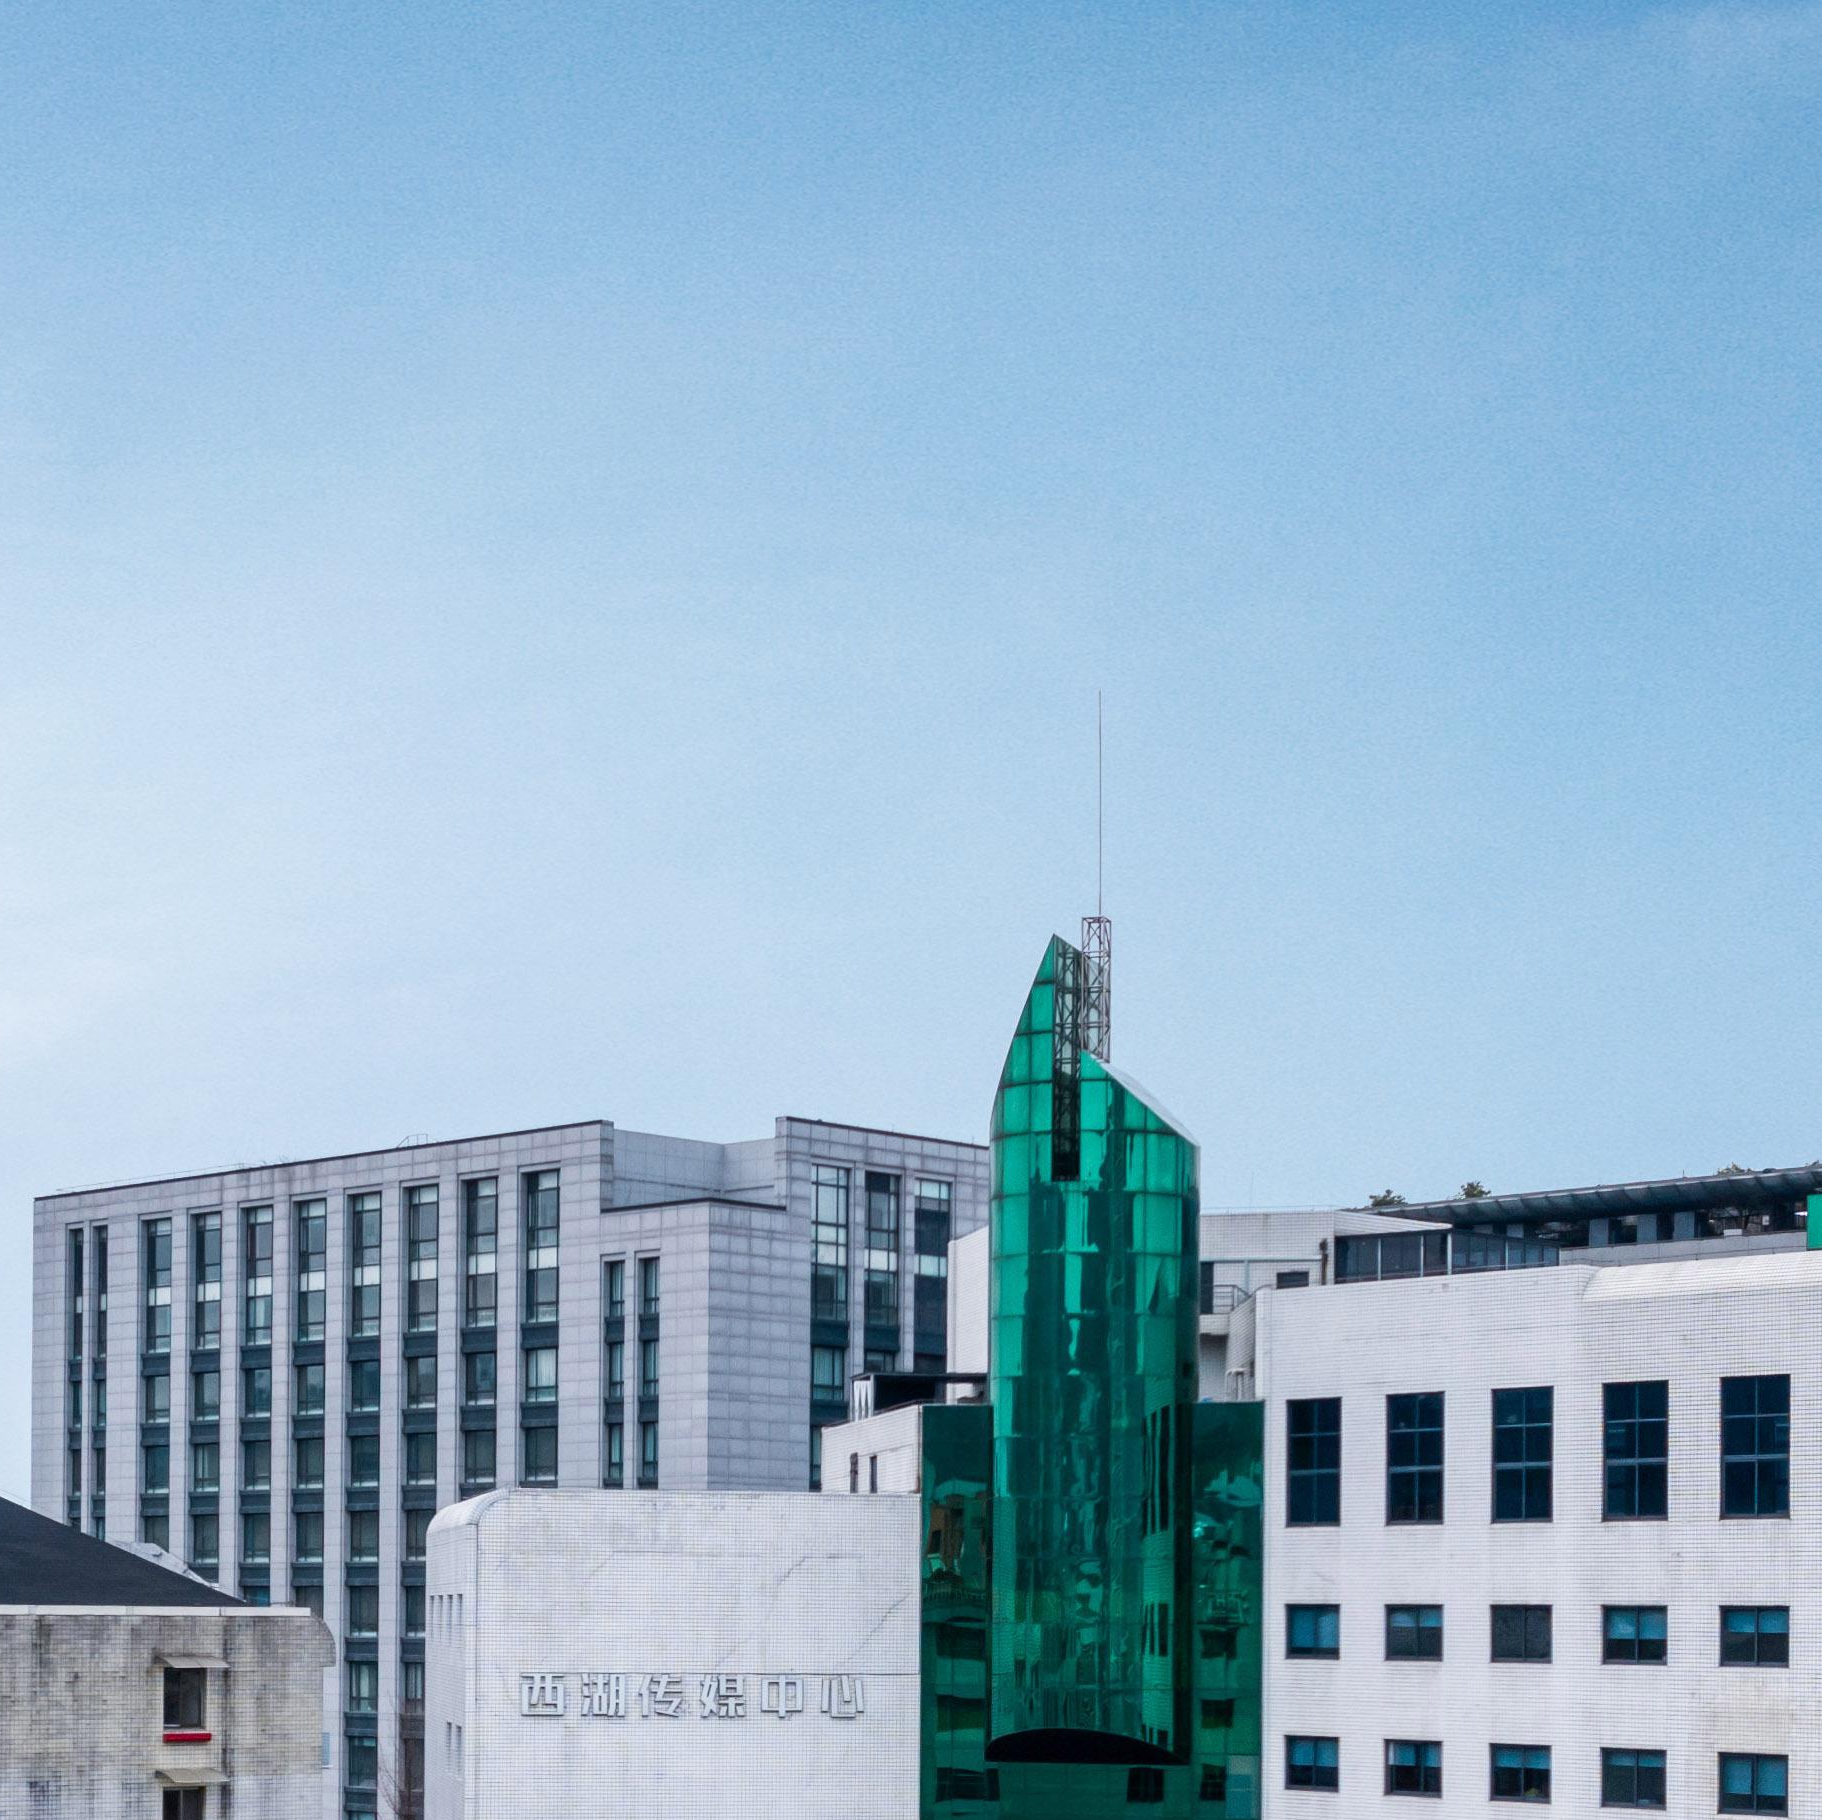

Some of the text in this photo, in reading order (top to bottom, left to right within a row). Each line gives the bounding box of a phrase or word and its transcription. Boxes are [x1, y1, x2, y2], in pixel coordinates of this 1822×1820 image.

[520, 1672, 866, 1719] 西湖传媒中心
